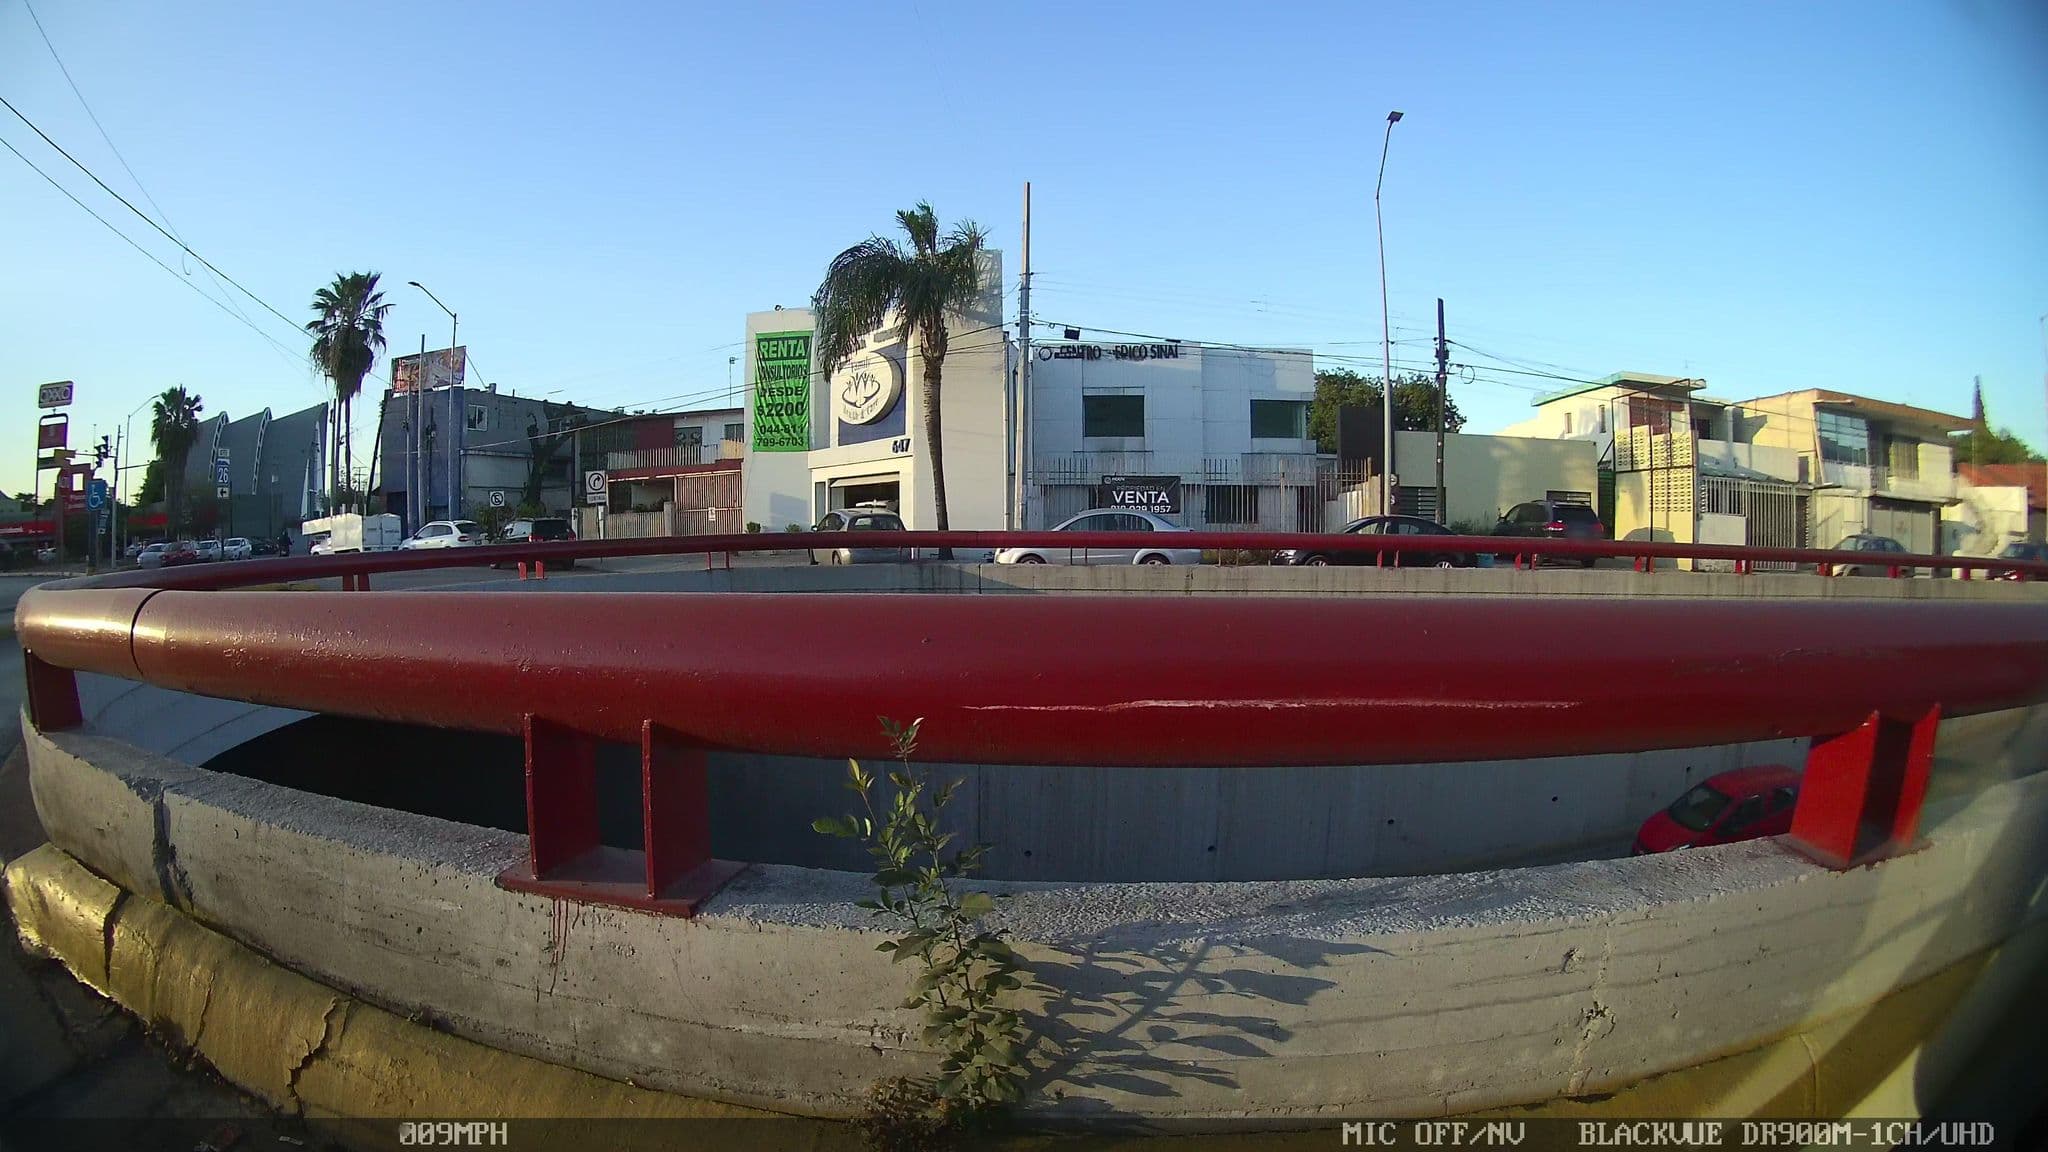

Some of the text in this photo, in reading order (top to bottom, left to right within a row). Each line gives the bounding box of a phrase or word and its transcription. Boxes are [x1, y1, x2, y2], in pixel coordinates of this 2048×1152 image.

[760, 339, 805, 358] RENTA
[40, 387, 71, 403] OXXO
[760, 386, 802, 397] DESDE
[892, 438, 911, 454] 647
[218, 468, 229, 483] 26
[1112, 490, 1169, 504] VENTA
